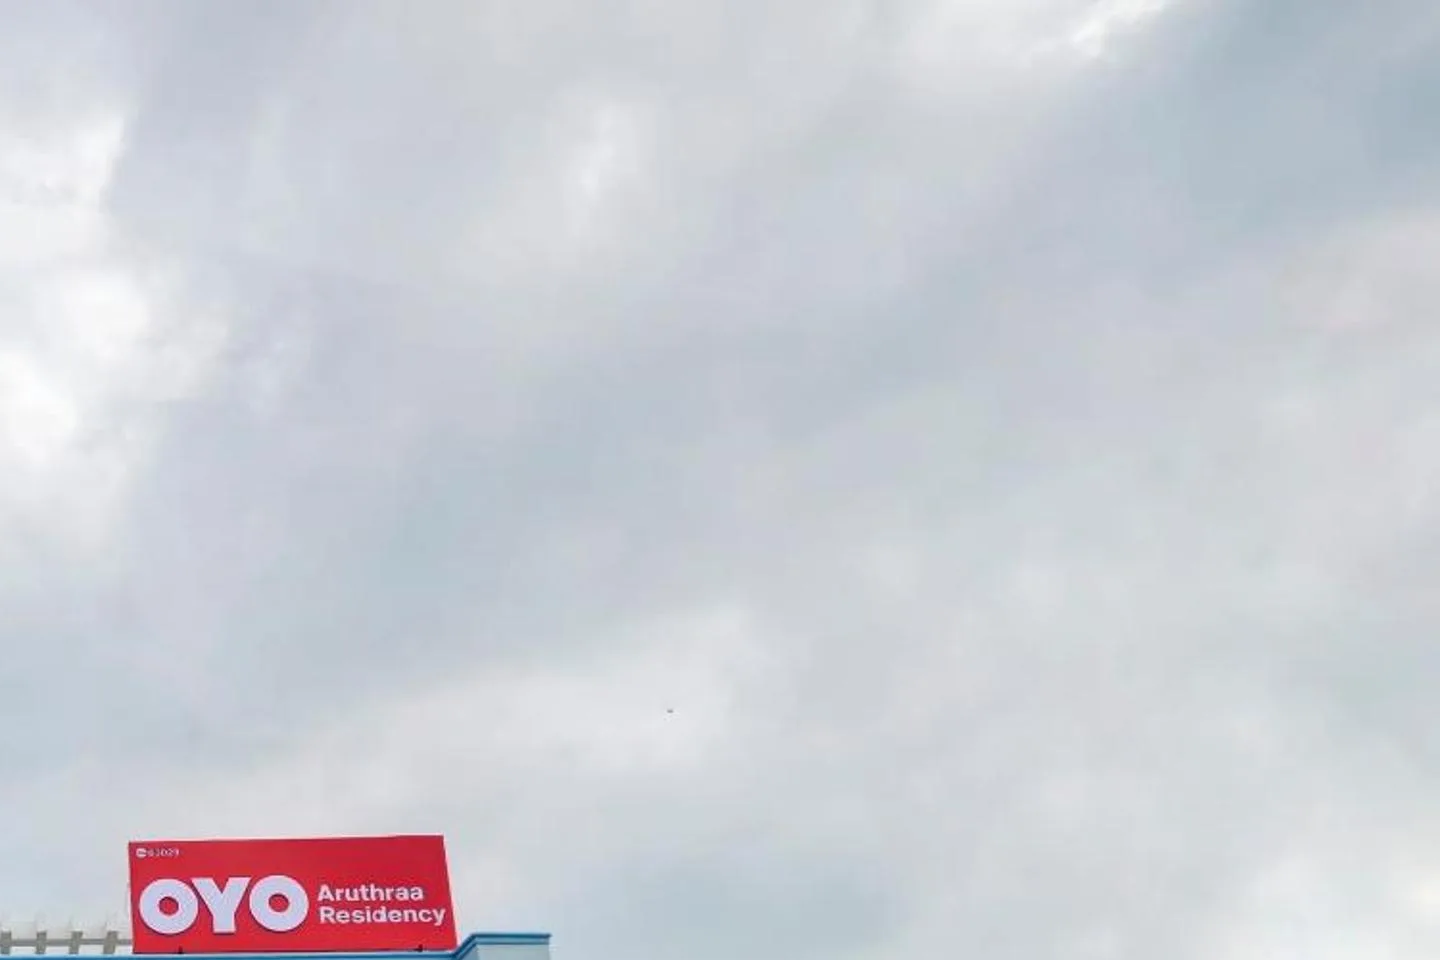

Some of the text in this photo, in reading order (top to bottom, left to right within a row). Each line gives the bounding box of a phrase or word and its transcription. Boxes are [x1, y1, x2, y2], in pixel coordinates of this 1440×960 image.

[317, 883, 424, 903] Aruthraa
[139, 874, 309, 934] OYO
[318, 905, 446, 926] Residency
